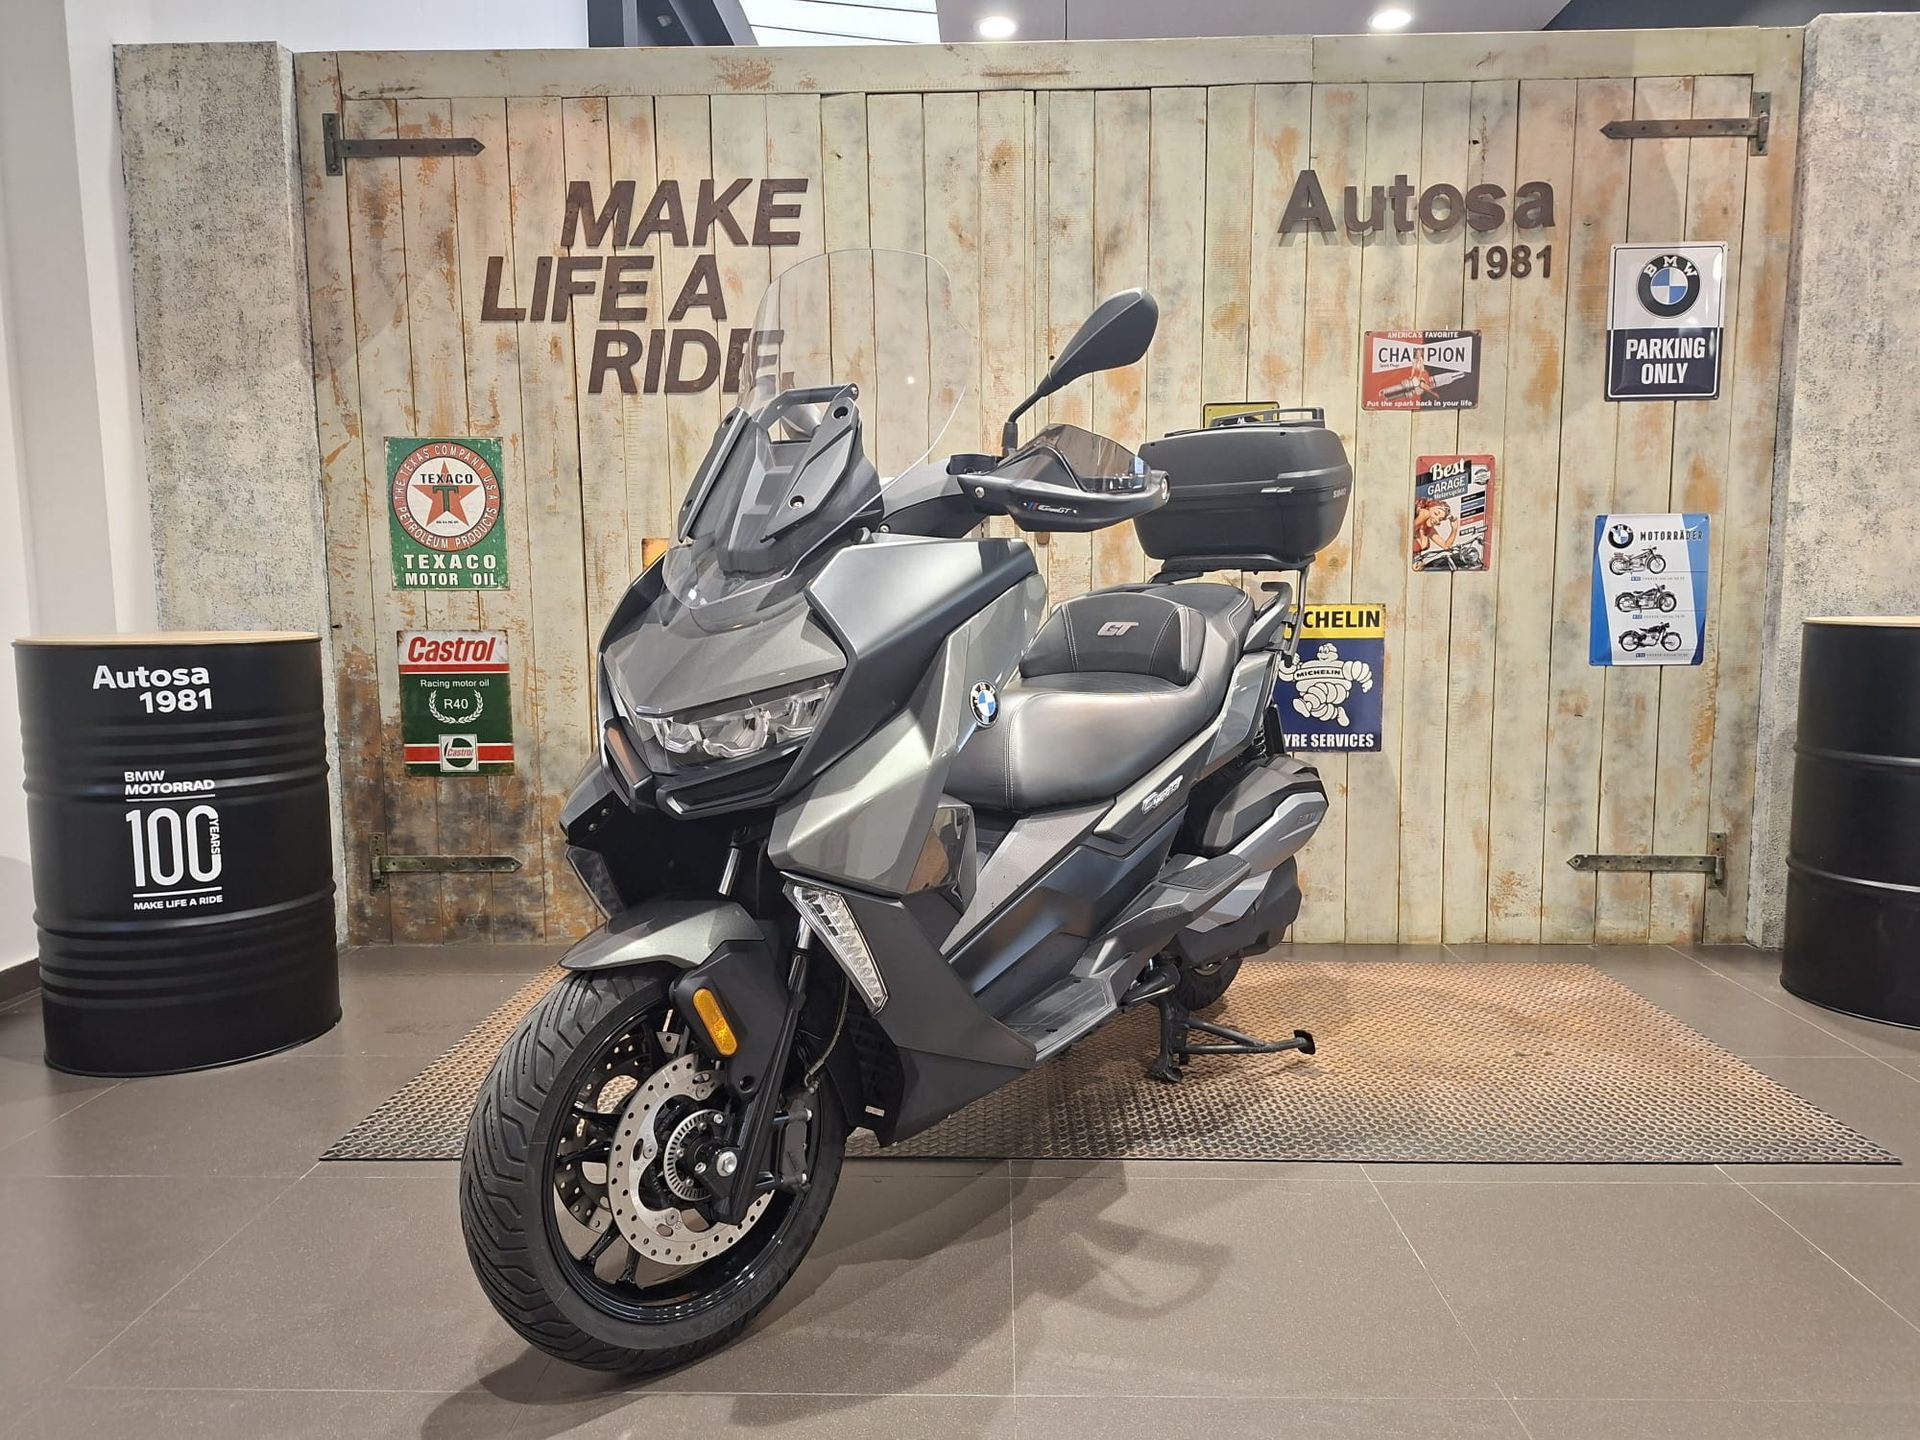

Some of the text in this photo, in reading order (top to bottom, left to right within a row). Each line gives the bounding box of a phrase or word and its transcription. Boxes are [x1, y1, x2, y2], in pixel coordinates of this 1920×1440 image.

[1277, 169, 1556, 233] Autosa
[560, 178, 808, 247] MAKE
[1464, 245, 1552, 280] 1981
[1644, 256, 1698, 278] BMW
[480, 254, 728, 322] LIFE A
[1626, 338, 1706, 360] PARKING
[1641, 362, 1688, 384] ONLY
[400, 448, 430, 476] TEXAS
[434, 444, 486, 471] COMPANY
[420, 474, 473, 484] TEXACO
[1430, 458, 1465, 480] Best
[395, 480, 406, 500] THE
[1428, 476, 1466, 496] GARAGE
[396, 506, 498, 549] PETROLEUM PRODUCTS
[404, 554, 496, 569] TEXACO
[406, 572, 498, 586] MOTOR OIL
[1097, 621, 1139, 636] GT
[1303, 610, 1380, 628] CHELIN
[408, 636, 496, 662] Castrol
[92, 665, 210, 689] Autosa
[420, 679, 450, 689] Racing
[1296, 670, 1341, 678] MICHELIN
[139, 688, 212, 713] 1981
[444, 698, 469, 710] R40
[1283, 734, 1374, 747] YRE SERVICES
[447, 748, 474, 757] Castrol
[124, 770, 165, 782] BMW
[124, 780, 215, 796] MOTORRAD
[125, 805, 222, 887] 100
[208, 818, 221, 854] YEARS
[134, 895, 223, 910] MAKE LIFE A RIDE
